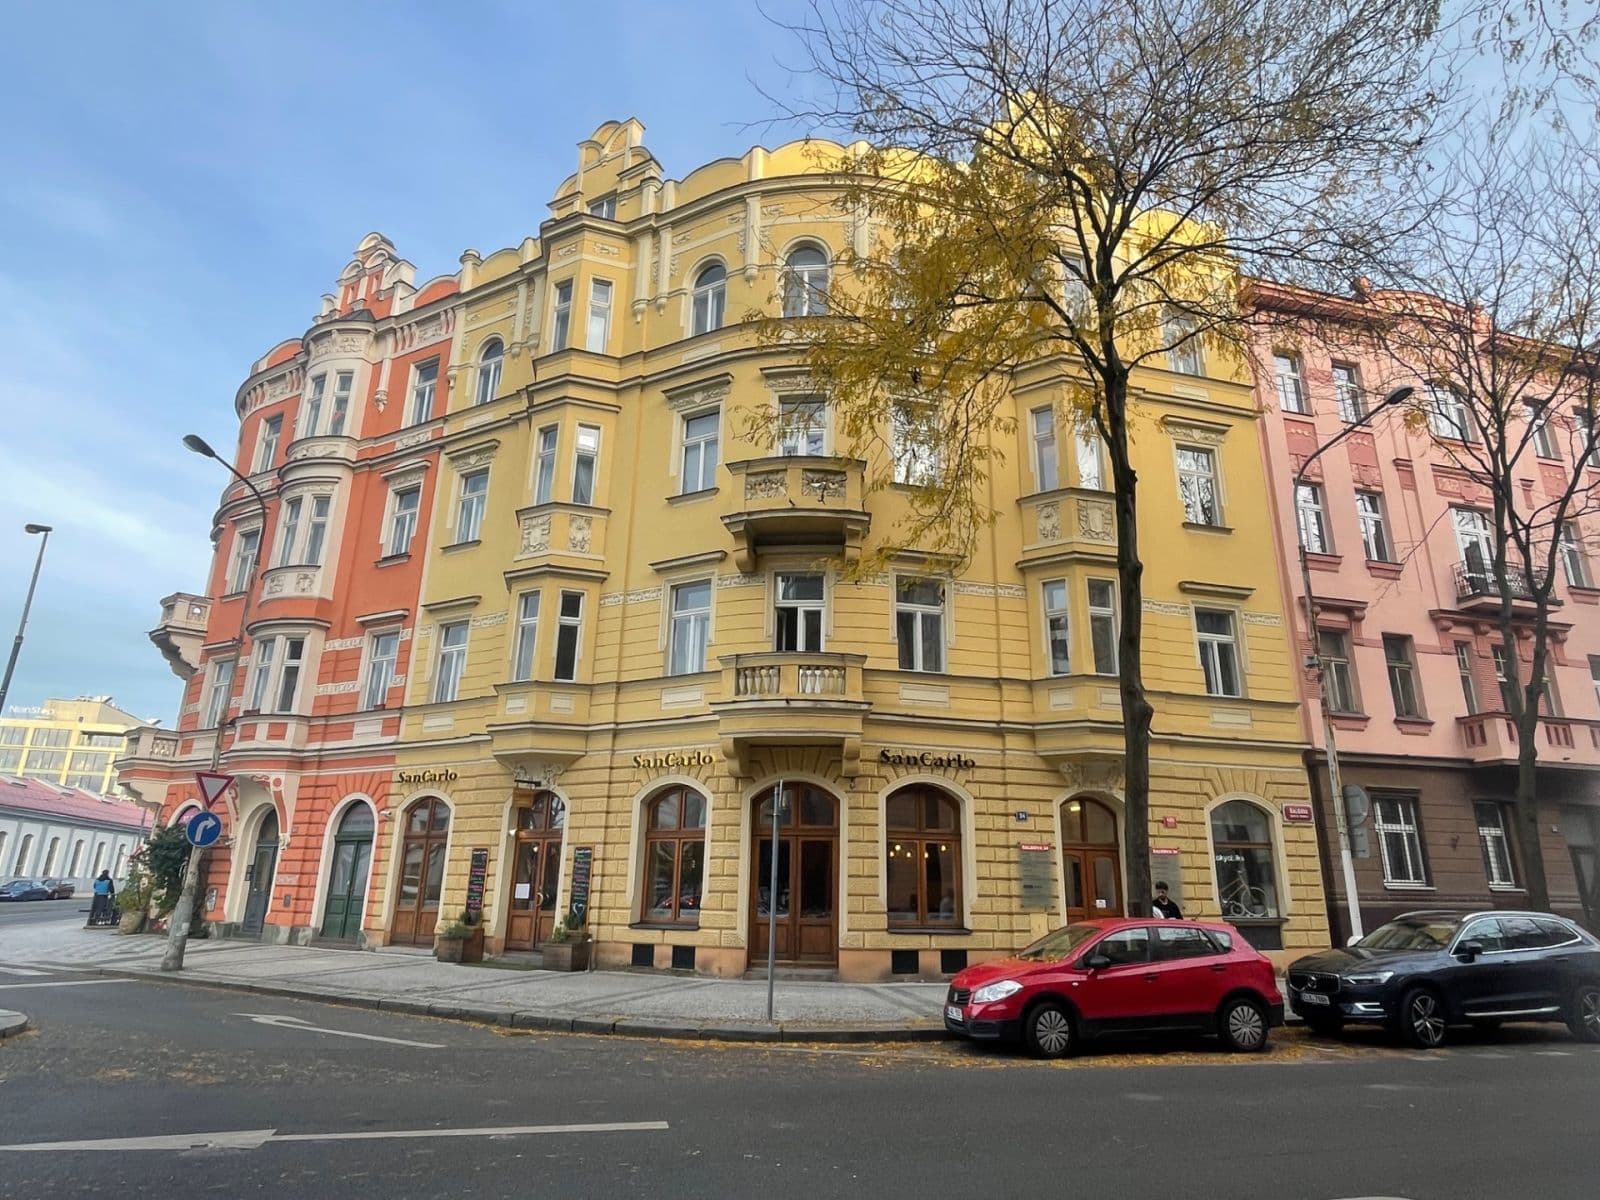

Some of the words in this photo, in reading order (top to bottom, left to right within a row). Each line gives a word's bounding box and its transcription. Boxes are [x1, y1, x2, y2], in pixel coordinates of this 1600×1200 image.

[632, 752, 714, 769] SanCarlo
[880, 749, 976, 768] SanCarlo
[397, 769, 458, 783] SanCarlo
